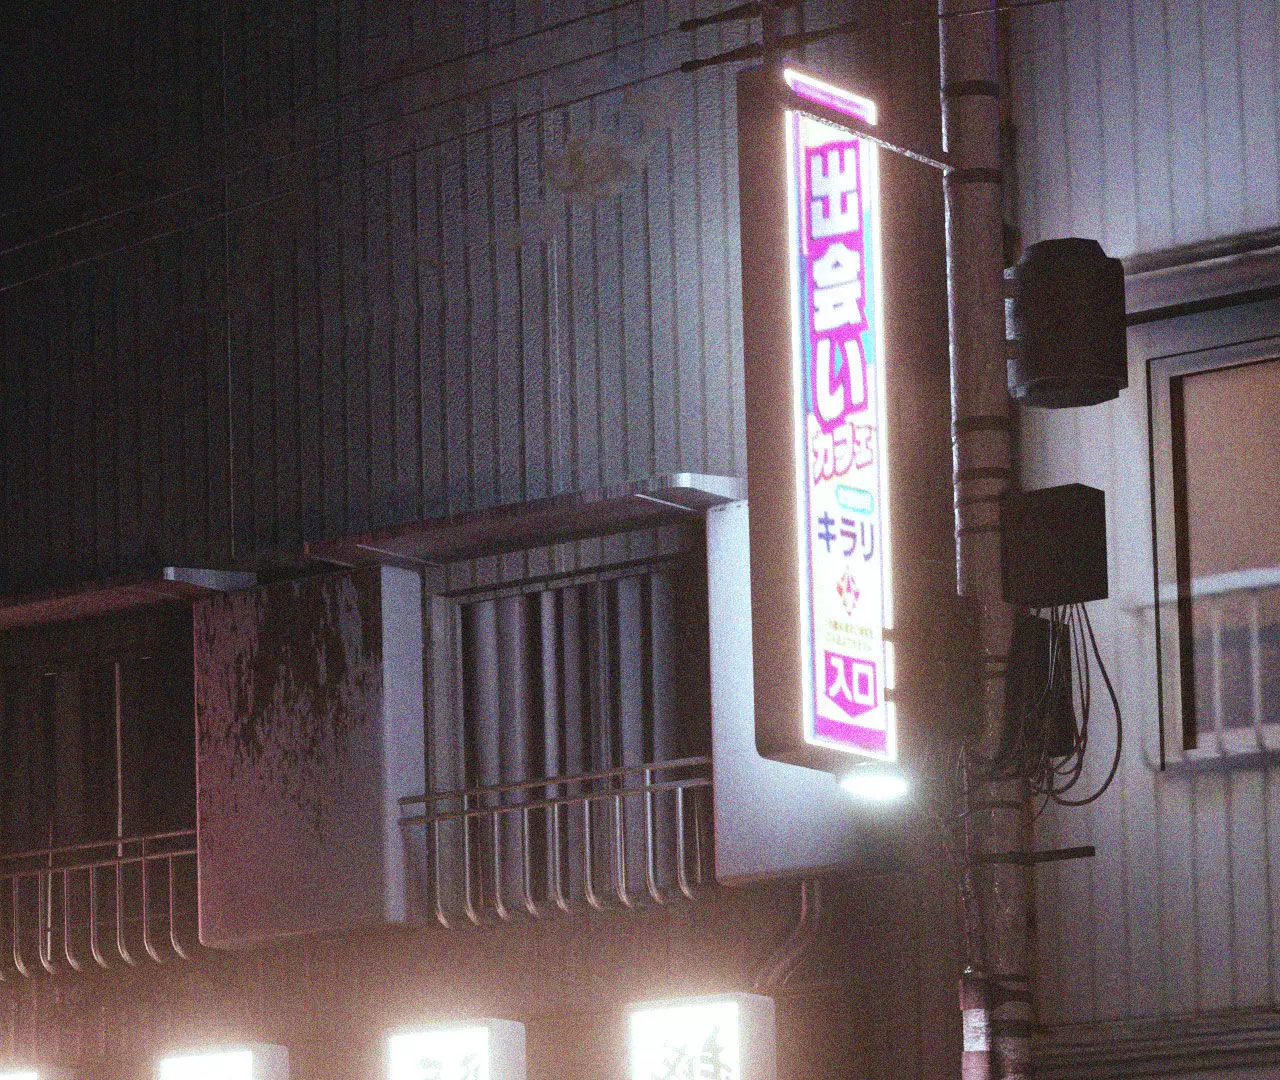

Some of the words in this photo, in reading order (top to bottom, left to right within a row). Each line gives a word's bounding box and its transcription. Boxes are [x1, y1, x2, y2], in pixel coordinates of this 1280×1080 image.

[818, 511, 875, 562] キラリ
[827, 654, 871, 706] 入口
